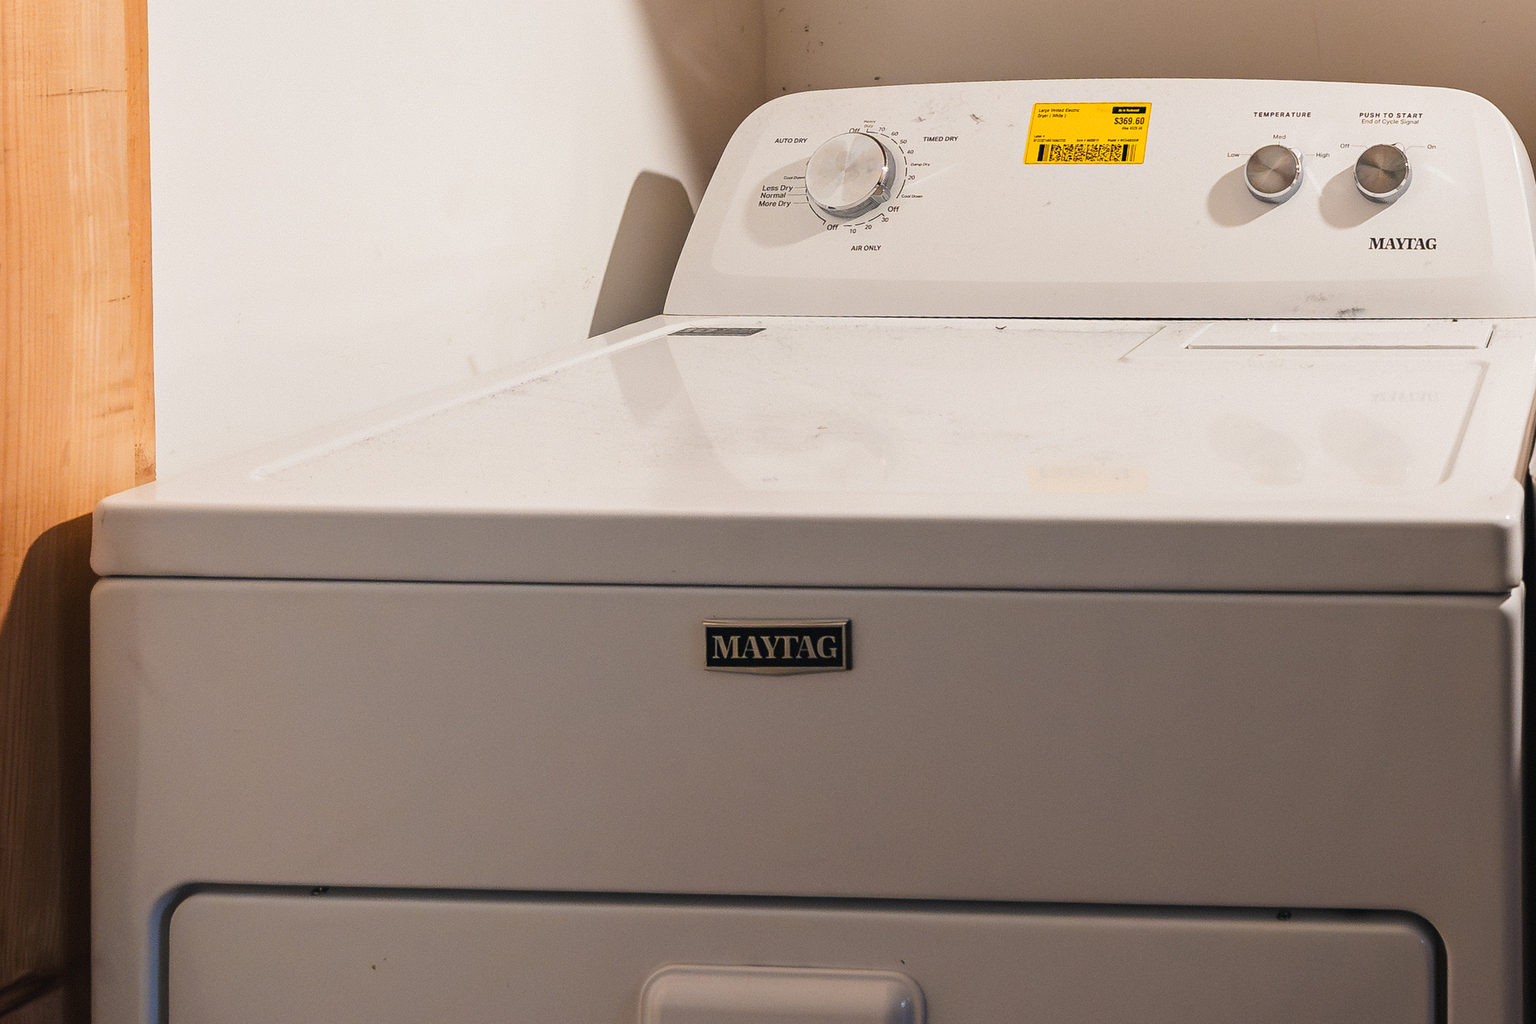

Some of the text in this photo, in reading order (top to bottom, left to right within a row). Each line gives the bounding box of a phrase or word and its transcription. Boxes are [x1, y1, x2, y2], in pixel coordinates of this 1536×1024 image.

[1113, 116, 1145, 125] $369.60
[762, 184, 793, 193] Less Dry
[778, 200, 792, 208] Dry
[887, 205, 900, 213] Off
[863, 244, 882, 252] ONLY
[1368, 237, 1438, 251] MAYTAG
[712, 635, 838, 659] MAYTAG
